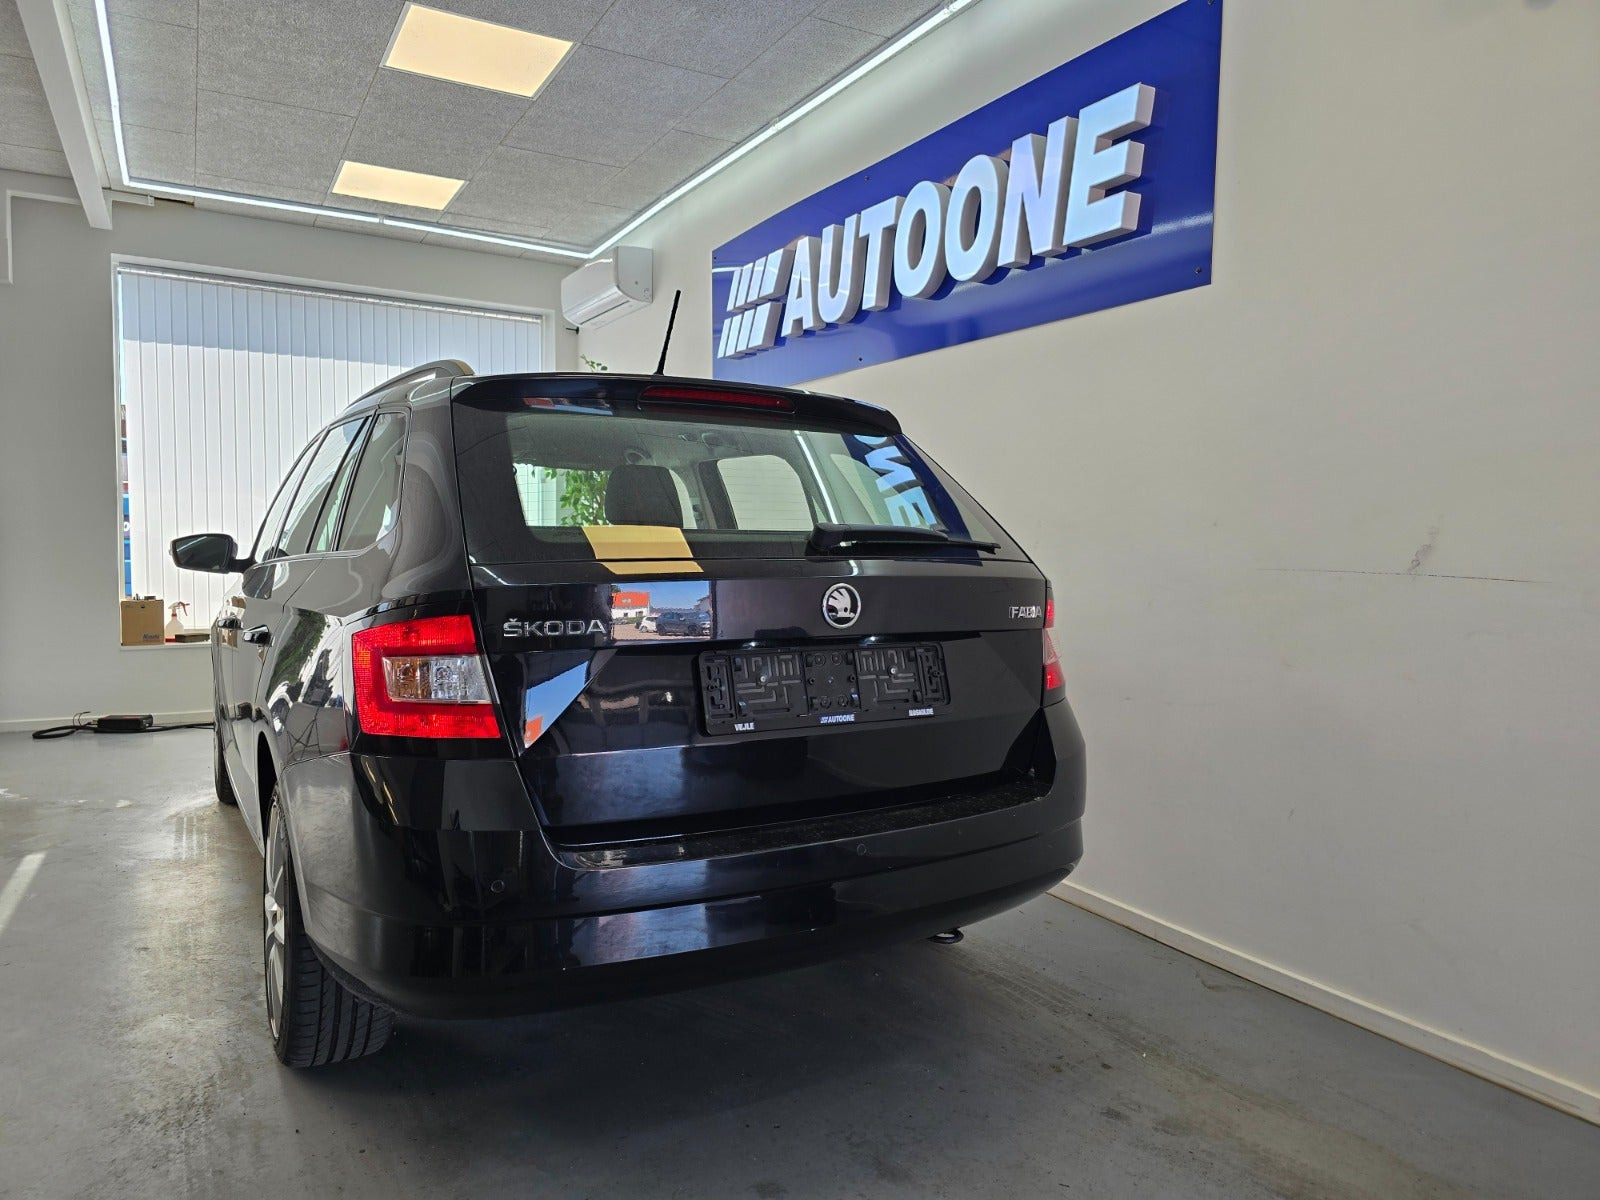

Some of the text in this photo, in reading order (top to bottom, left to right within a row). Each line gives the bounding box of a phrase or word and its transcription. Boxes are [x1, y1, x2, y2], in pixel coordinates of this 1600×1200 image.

[781, 82, 1156, 338] AUTOONE
[503, 618, 607, 637] ŠKODA
[734, 722, 755, 731] VEJLE
